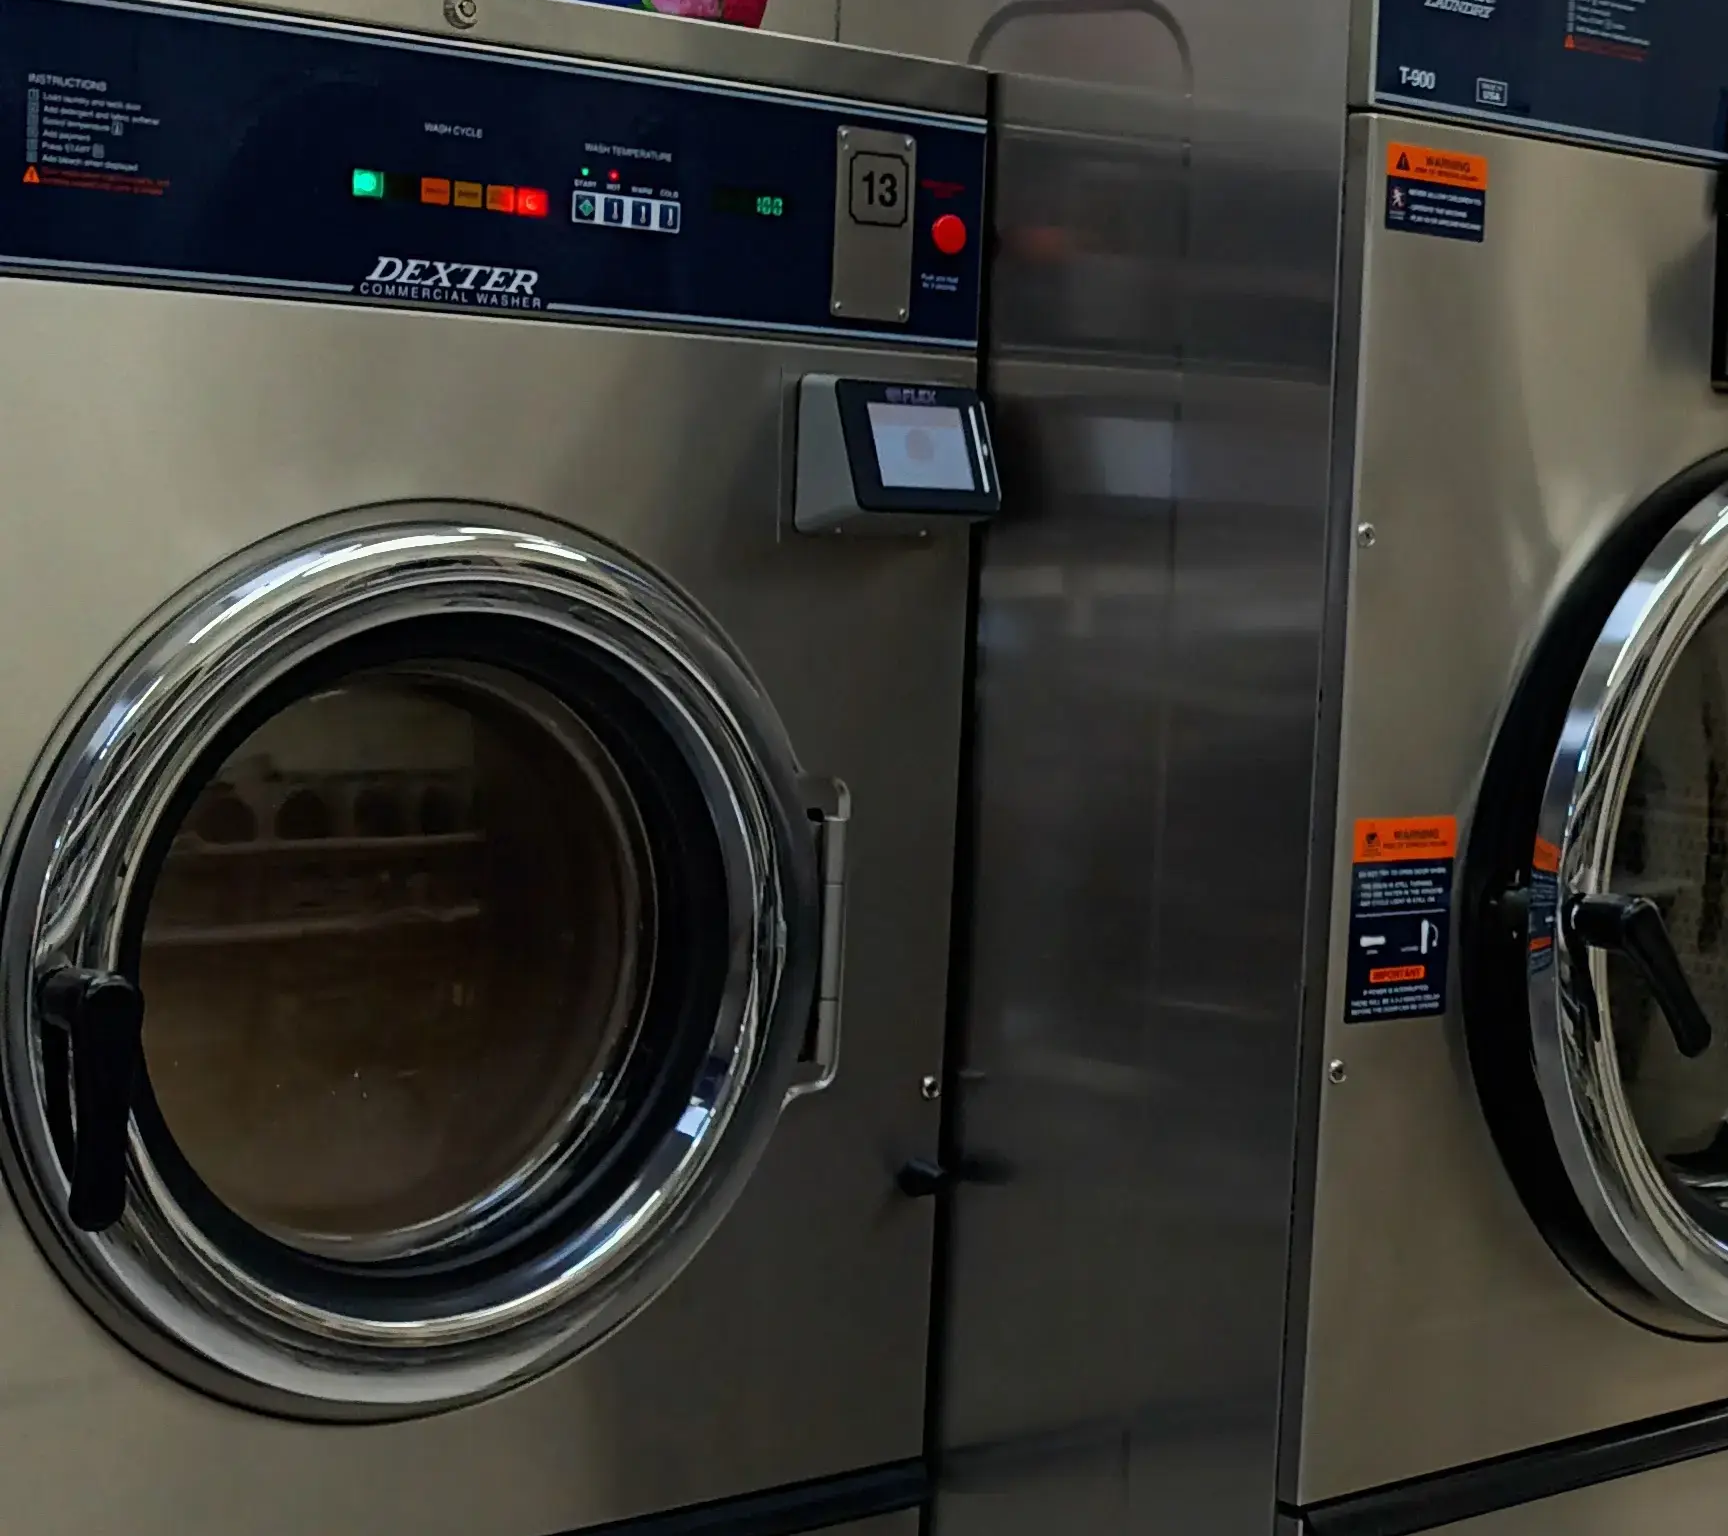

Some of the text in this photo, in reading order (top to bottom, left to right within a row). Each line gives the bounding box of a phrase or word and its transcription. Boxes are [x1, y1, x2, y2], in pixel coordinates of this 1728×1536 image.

[28, 73, 107, 92] INSTRUCTIONS
[1399, 66, 1436, 89] T-900
[424, 122, 484, 139] WASH CYCLE
[584, 142, 673, 163] WASH TEMPERATURE
[862, 170, 898, 207] 13
[365, 255, 539, 295] DEXTER
[360, 281, 541, 309] COMMERCIAL WASHER
